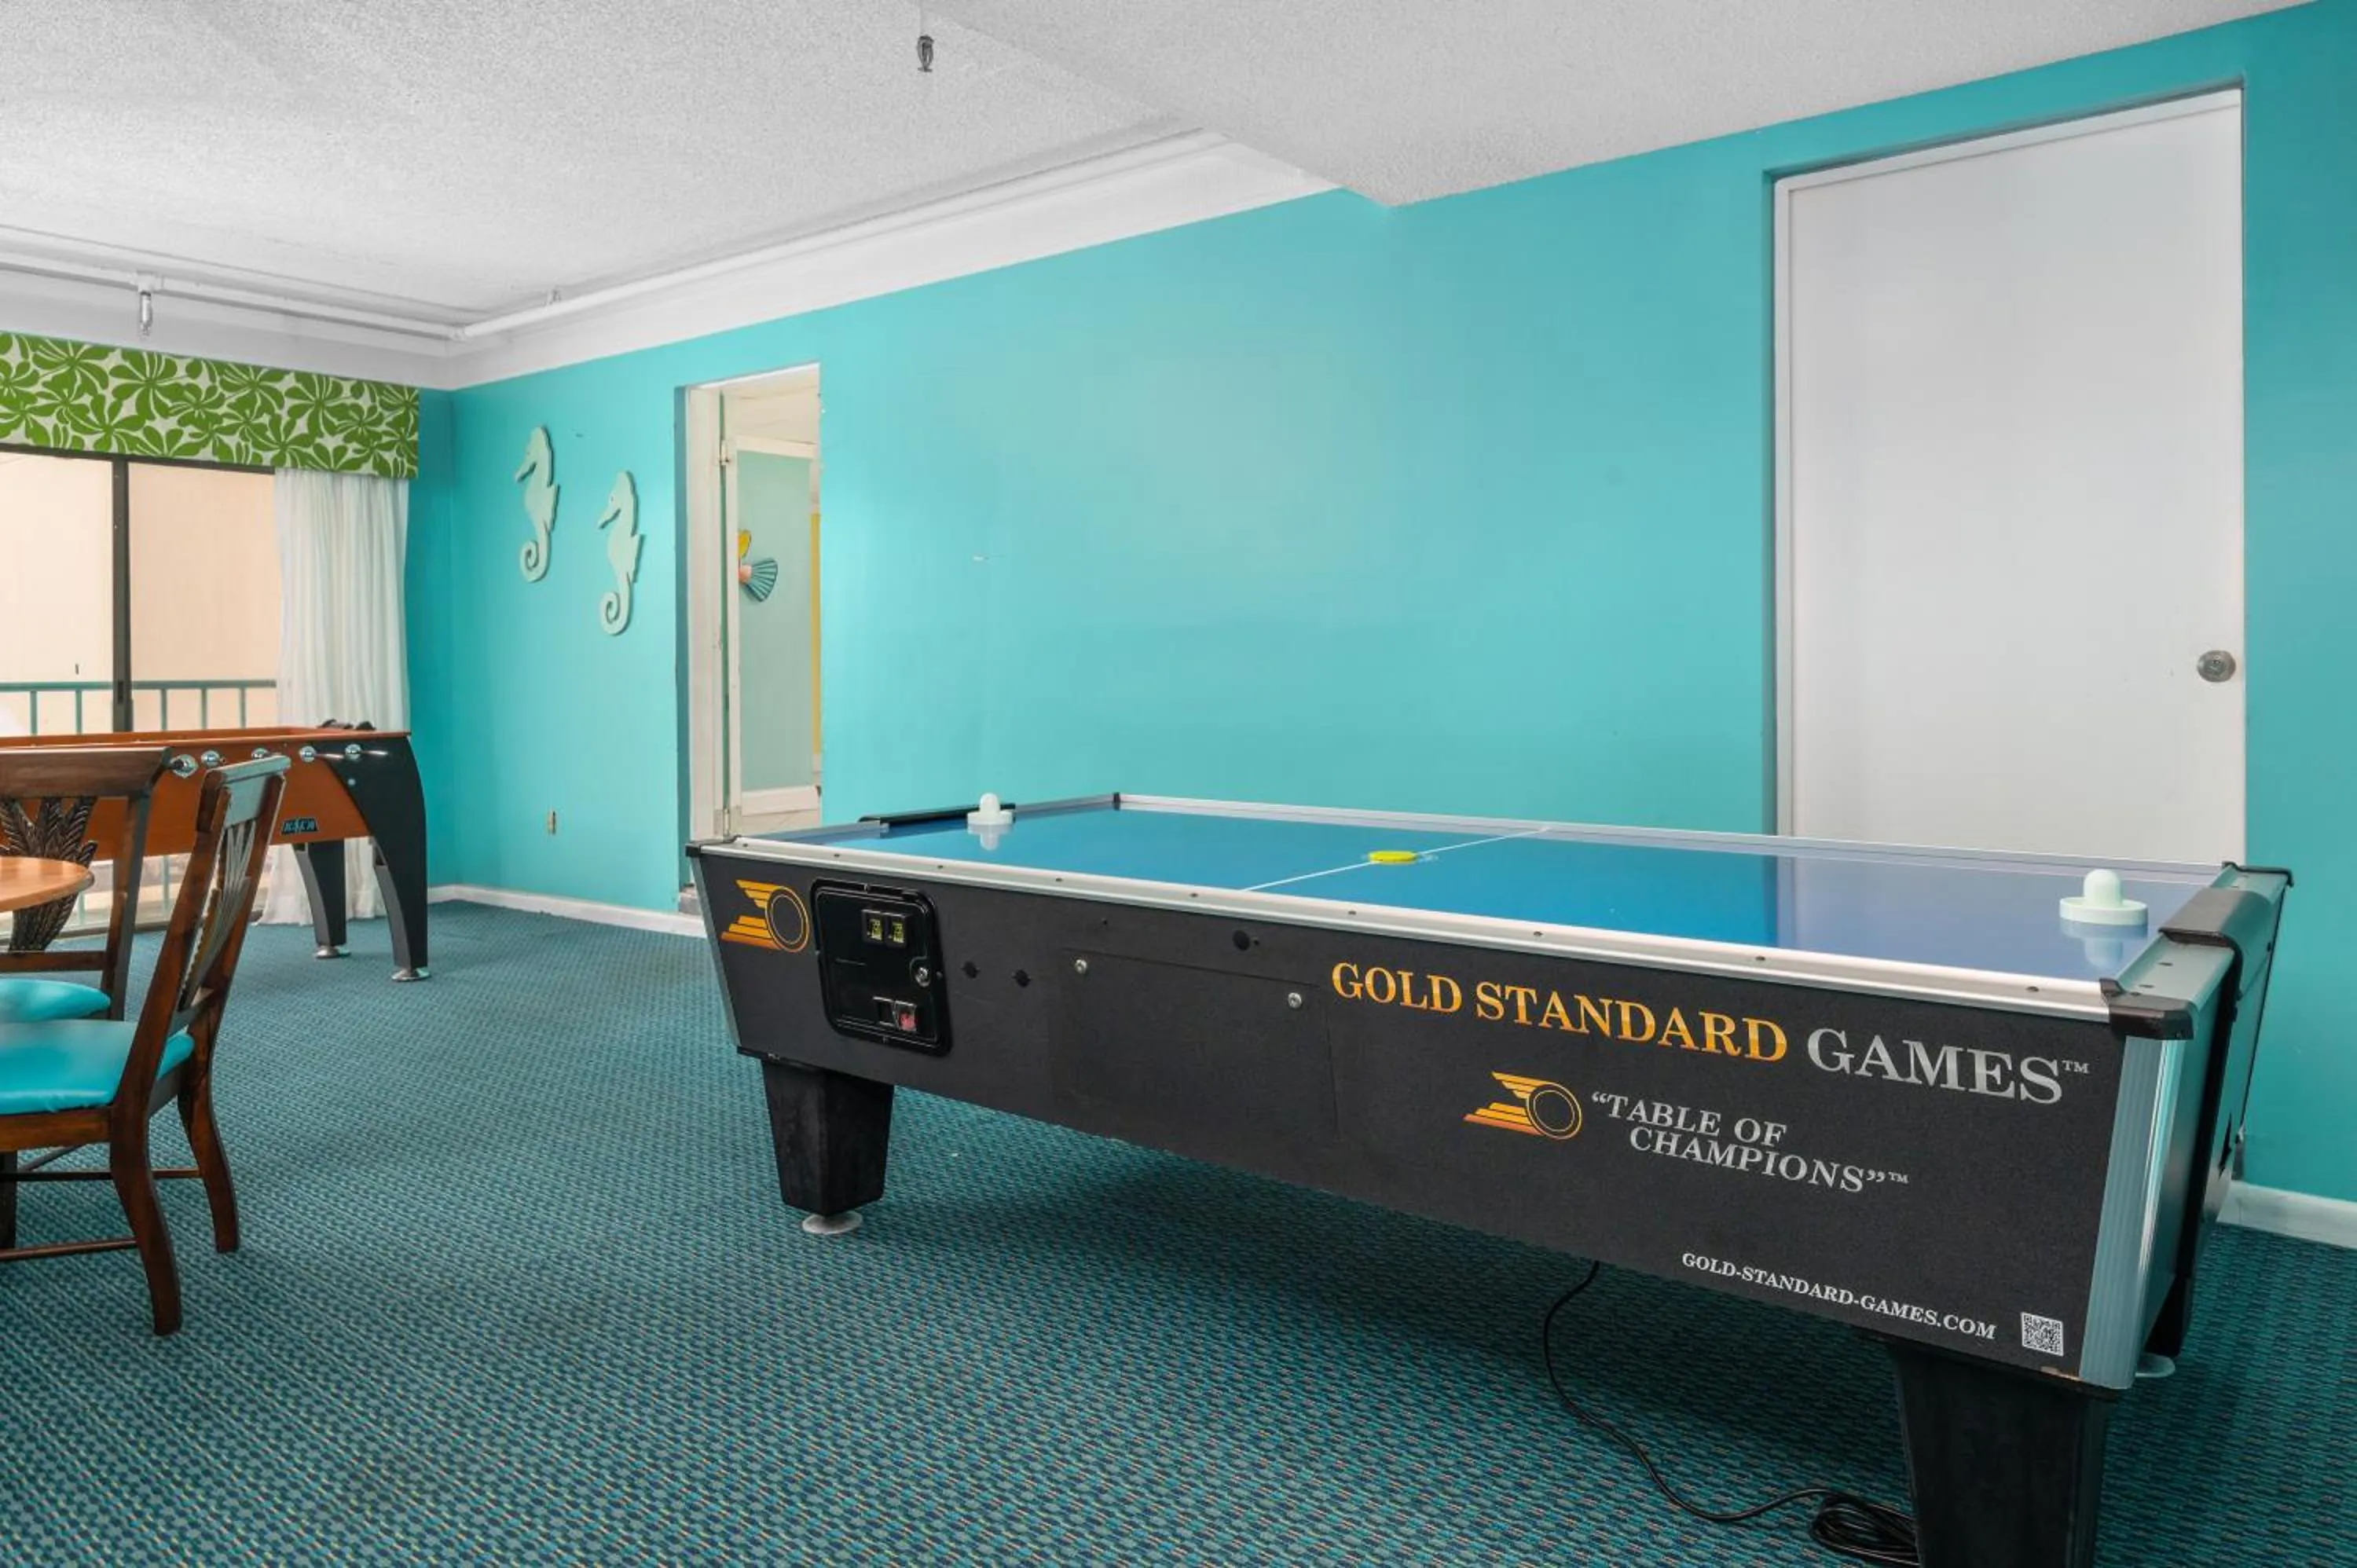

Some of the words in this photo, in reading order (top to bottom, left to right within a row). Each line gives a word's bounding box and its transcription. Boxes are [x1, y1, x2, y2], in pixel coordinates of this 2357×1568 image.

[1332, 962, 1463, 1013] GOLD
[1475, 981, 1787, 1063] STANDARD
[1734, 1117, 1788, 1149] OF
[1682, 1252, 1998, 1340] GOLD-STANDARD-GAMES.COM
